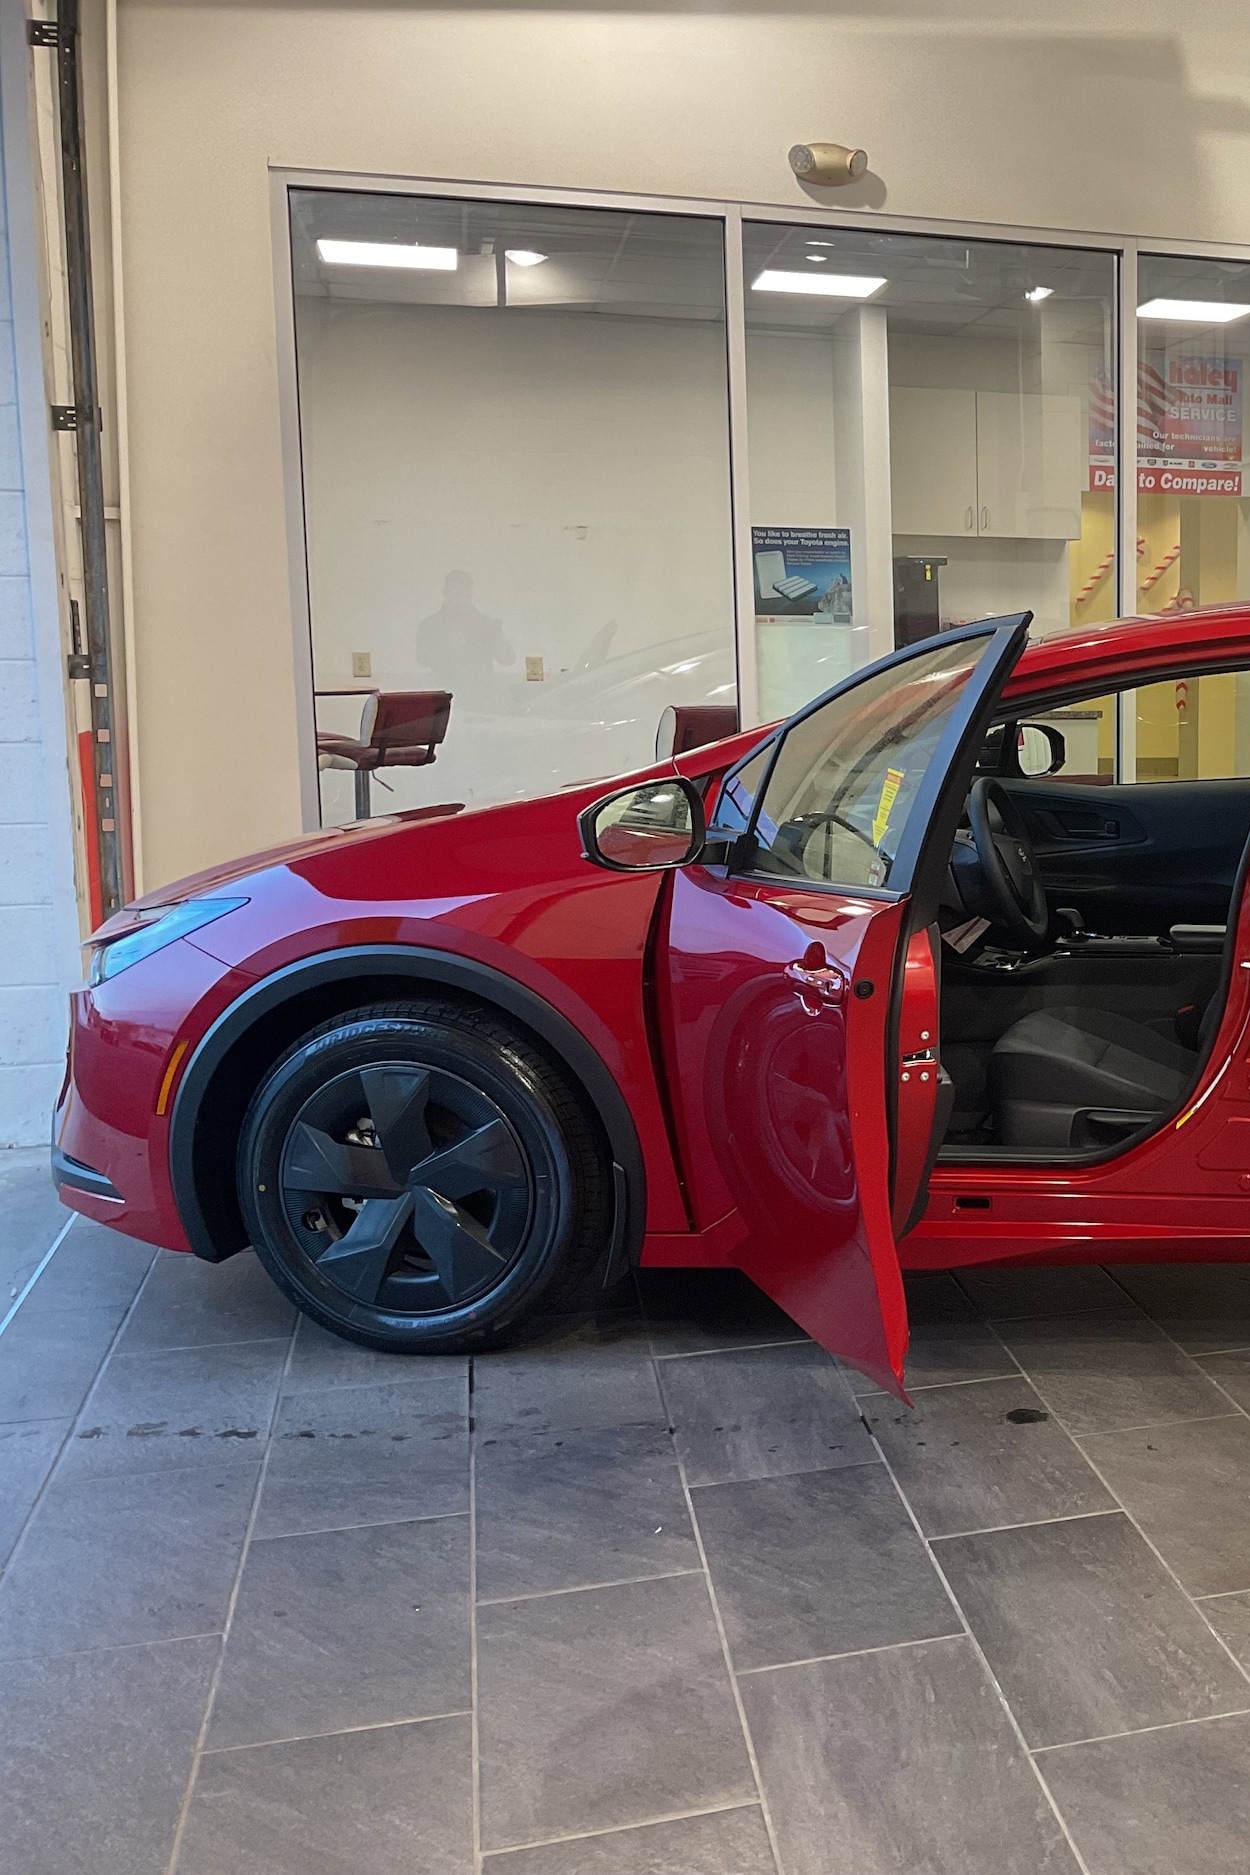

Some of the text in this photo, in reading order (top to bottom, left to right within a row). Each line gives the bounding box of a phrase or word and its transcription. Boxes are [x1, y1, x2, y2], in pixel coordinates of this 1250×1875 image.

[1169, 361, 1238, 393] haley
[1206, 394, 1232, 405] Mall
[1170, 407, 1236, 421] SERVICE
[1153, 431, 1169, 439] Our
[1171, 433, 1220, 442] technicians
[1162, 443, 1175, 452] for
[1094, 470, 1239, 493] Da to Compare!
[753, 537, 764, 545] So
[800, 539, 823, 547] Toyota
